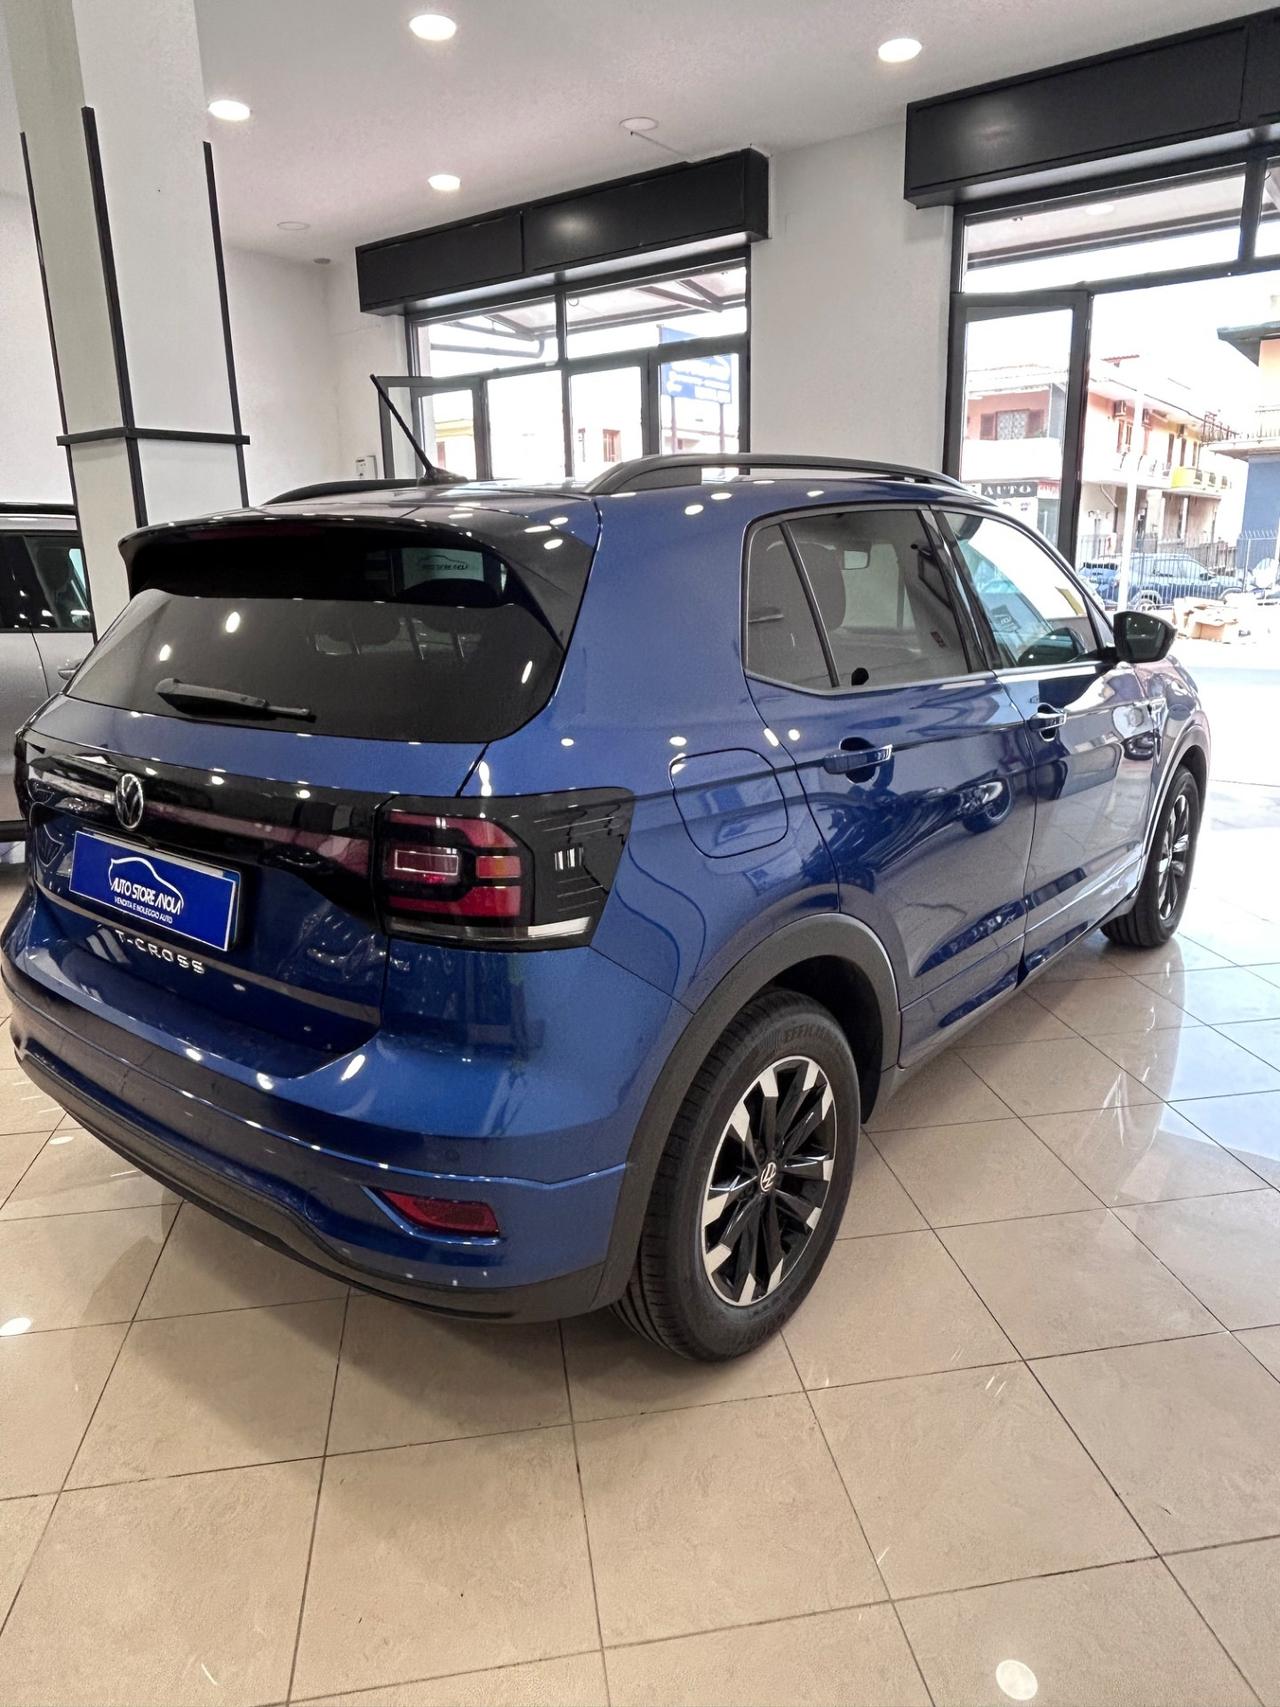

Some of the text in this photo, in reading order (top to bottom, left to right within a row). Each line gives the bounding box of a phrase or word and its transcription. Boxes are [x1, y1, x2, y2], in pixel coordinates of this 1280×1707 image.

[983, 484, 1032, 496] AUTO
[111, 877, 132, 896] AUTO
[132, 883, 156, 906] STORE
[115, 929, 206, 975] T-CROSS
